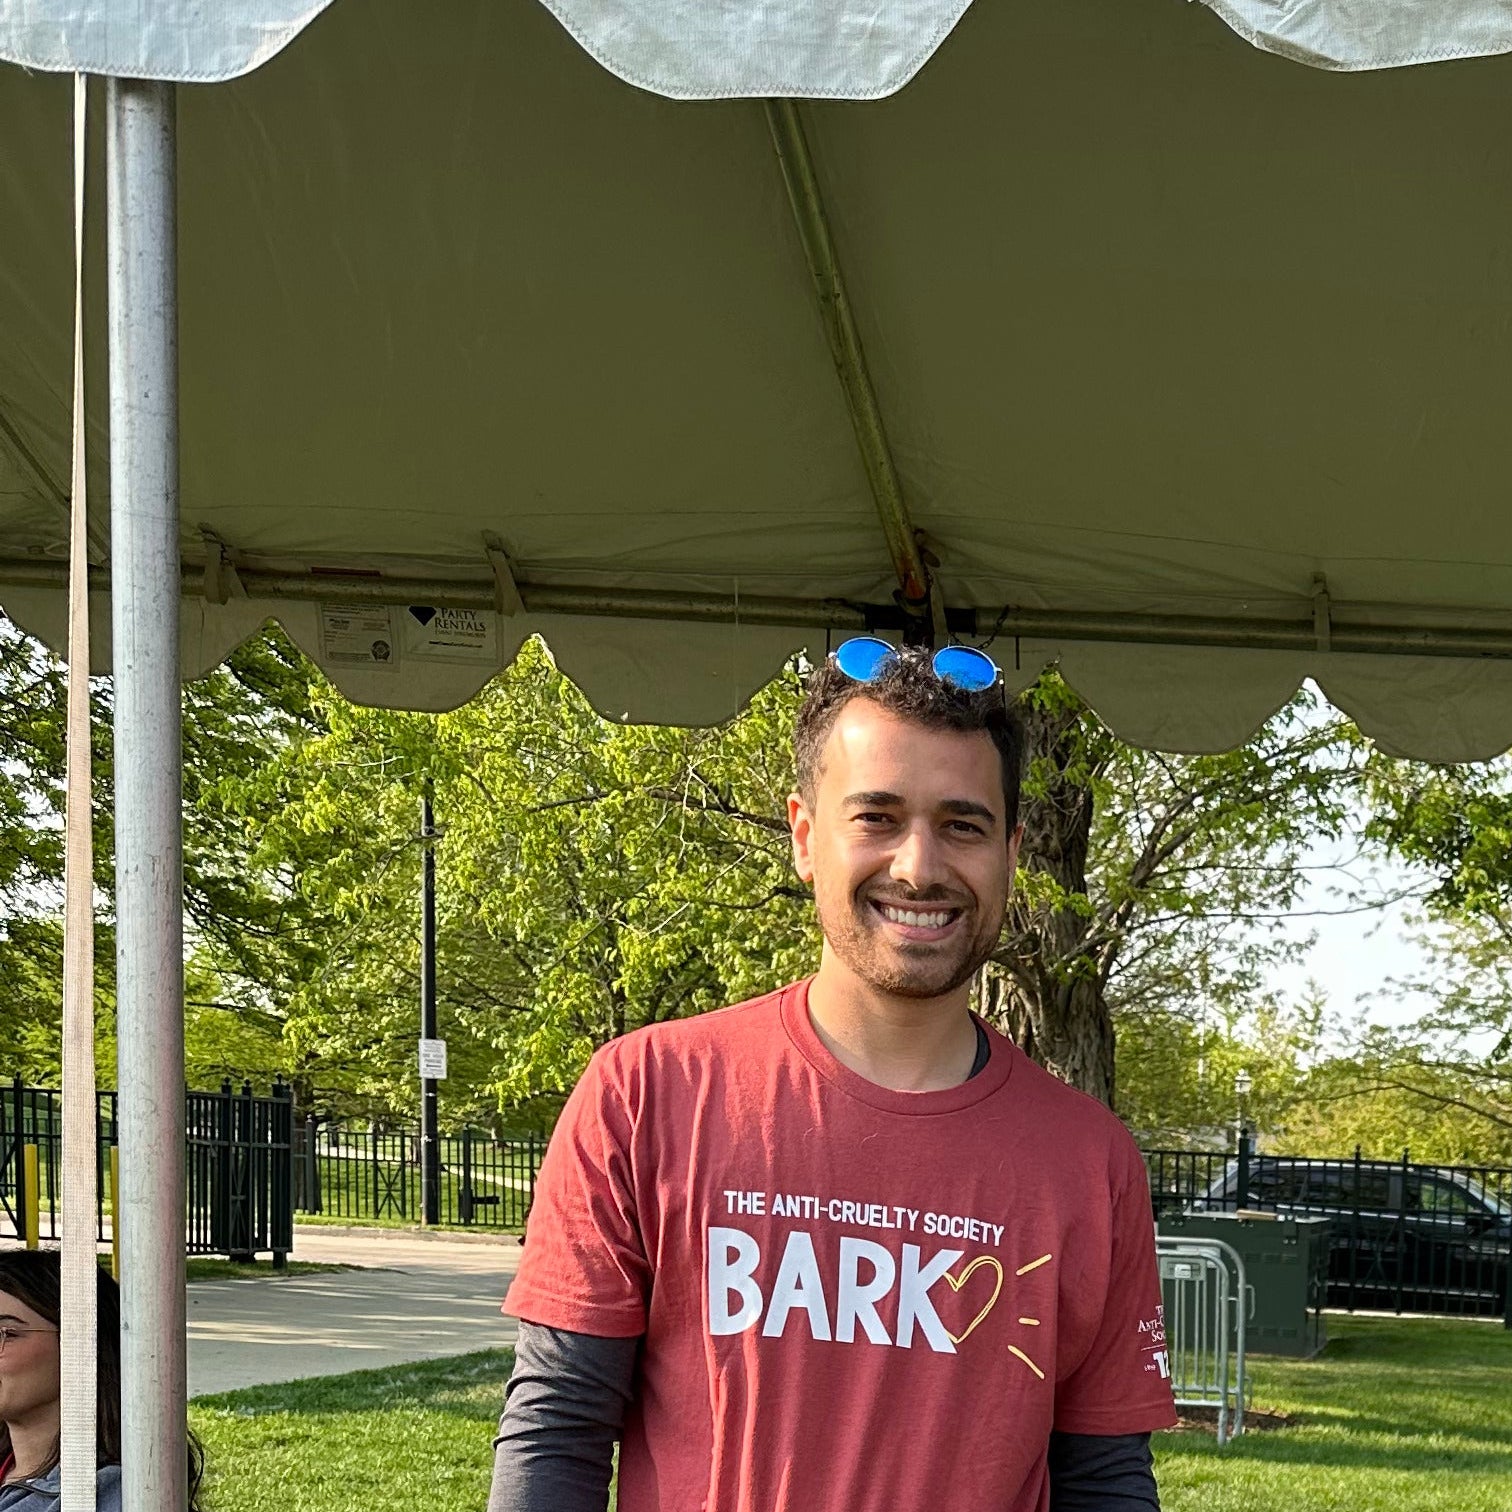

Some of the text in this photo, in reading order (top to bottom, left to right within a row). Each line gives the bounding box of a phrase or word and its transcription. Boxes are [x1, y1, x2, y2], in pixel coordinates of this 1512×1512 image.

[434, 617, 486, 632] RENTALS
[441, 607, 477, 621] PARTY
[723, 1190, 1005, 1247] THE ANTI-CRUELTY SOCIETY
[707, 1226, 964, 1354] BARK
